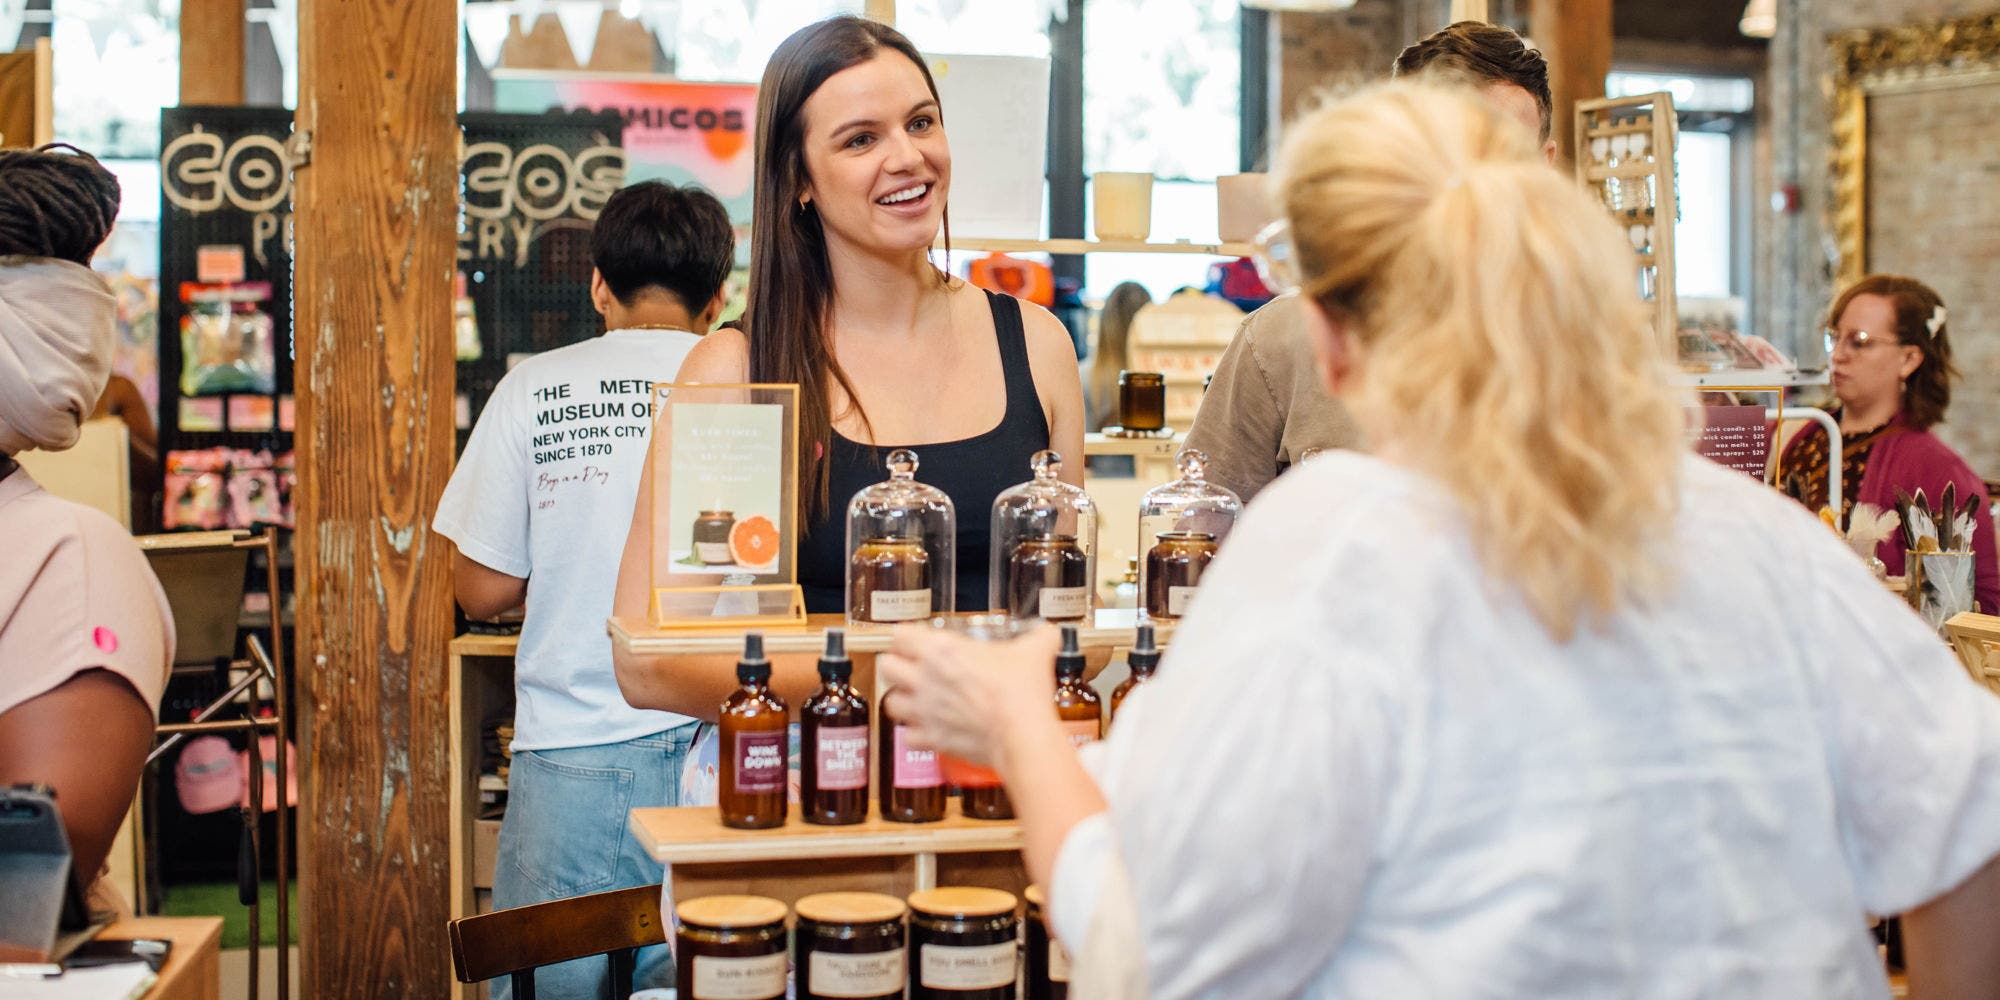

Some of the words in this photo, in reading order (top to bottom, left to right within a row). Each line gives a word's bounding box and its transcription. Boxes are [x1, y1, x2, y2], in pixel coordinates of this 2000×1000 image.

[533, 384, 571, 402] THE
[537, 403, 625, 427] MUSEUM
[533, 431, 565, 448] NEW
[569, 426, 610, 441] YORK
[614, 425, 646, 438] CITY
[534, 447, 576, 465] SINCE
[580, 443, 612, 456] 1870
[1723, 449, 1745, 457] sprays
[747, 744, 779, 757] WINE
[744, 755, 782, 769] DOWN
